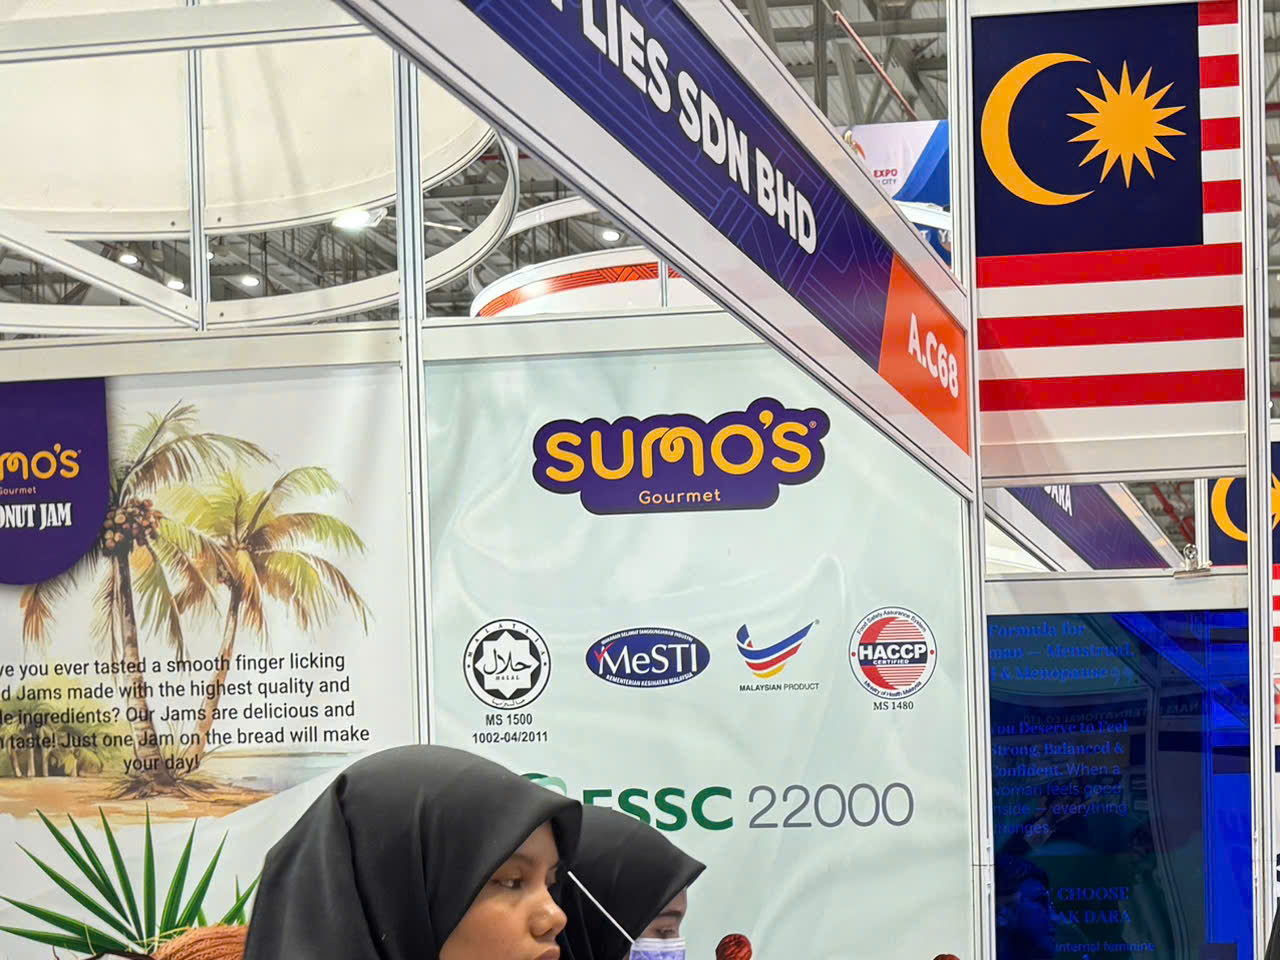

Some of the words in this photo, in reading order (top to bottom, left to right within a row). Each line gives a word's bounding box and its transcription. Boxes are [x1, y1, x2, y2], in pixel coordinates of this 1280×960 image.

[546, 0, 671, 113] LIES
[677, 70, 750, 195] SDN
[755, 147, 817, 254] BHD
[873, 169, 898, 178] EXPO
[908, 312, 959, 398] A.C68
[639, 489, 721, 505] Gourmet
[39, 502, 72, 531] JAM
[1062, 620, 1086, 637] for
[598, 643, 698, 675] MeSTI
[859, 643, 926, 660] HACCP
[20, 663, 48, 680] you
[54, 662, 89, 676] ever
[94, 657, 147, 675] tasted
[152, 661, 161, 673] a
[167, 655, 230, 673] smooth
[236, 653, 285, 674] finger
[290, 652, 345, 671] licking
[16, 685, 62, 701] Jams
[67, 682, 114, 699] made
[119, 681, 153, 698] with
[159, 680, 185, 697] the
[191, 679, 252, 699] highest
[257, 677, 314, 698] quality
[319, 676, 350, 693] and
[18, 707, 120, 728] ingredients?
[126, 707, 155, 722] Our
[161, 706, 207, 722] Jams
[212, 706, 238, 720] are
[243, 703, 319, 719] delicious
[324, 701, 355, 717] and
[873, 701, 889, 710] MS
[892, 700, 914, 710] 1480
[486, 714, 503, 726] MS
[506, 713, 533, 725] 1500
[10, 732, 56, 749] taste!
[61, 731, 97, 748] Just
[103, 734, 133, 747] one
[138, 731, 174, 746] Jam
[180, 732, 200, 745] on
[206, 728, 232, 745] the
[237, 727, 285, 744] bread
[290, 725, 318, 743] will
[323, 725, 370, 742] make
[472, 731, 548, 744] 1002-04/2011
[124, 756, 160, 776] your
[165, 754, 199, 773] day!
[748, 782, 914, 829] 22000
